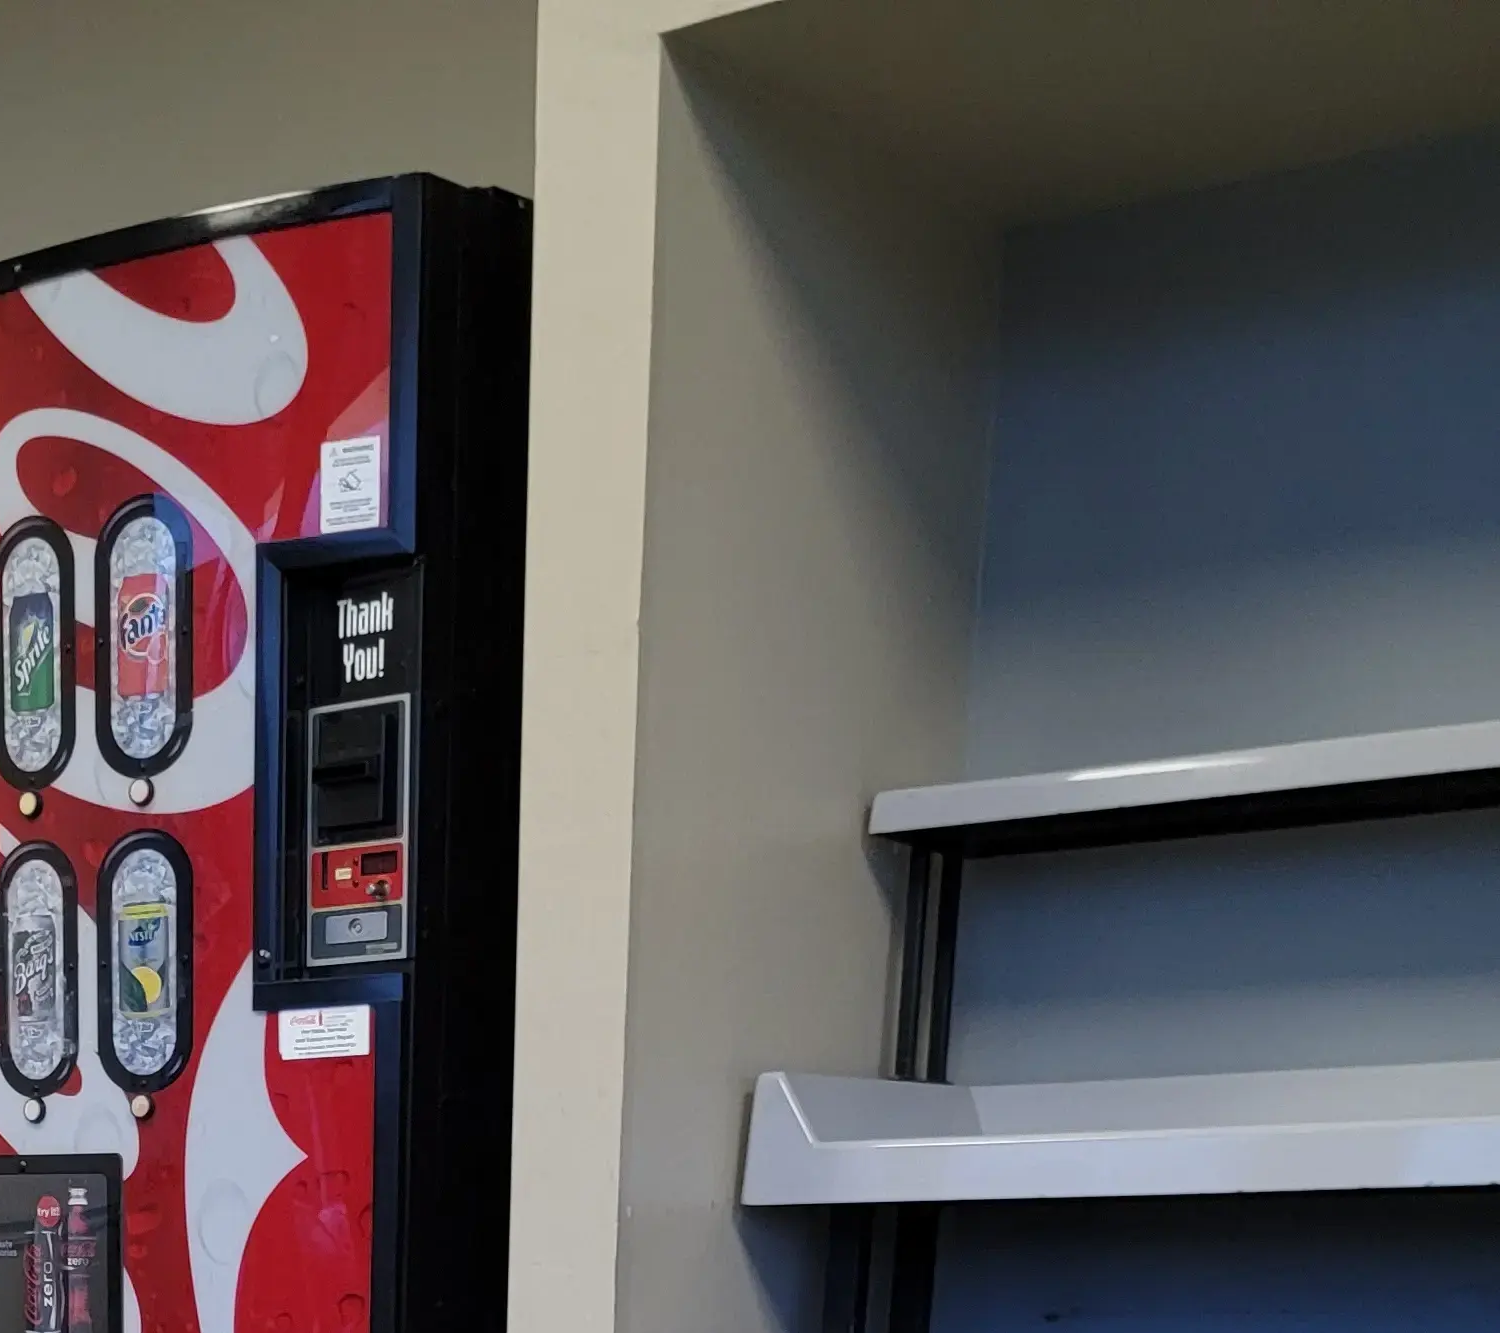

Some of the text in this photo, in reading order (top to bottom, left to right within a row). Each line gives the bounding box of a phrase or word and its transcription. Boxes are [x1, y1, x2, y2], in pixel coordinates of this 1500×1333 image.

[337, 591, 394, 640] Thank
[14, 624, 52, 692] Sprite
[342, 637, 385, 683] You!
[43, 1261, 54, 1308] zero
[67, 1256, 89, 1267] zero
